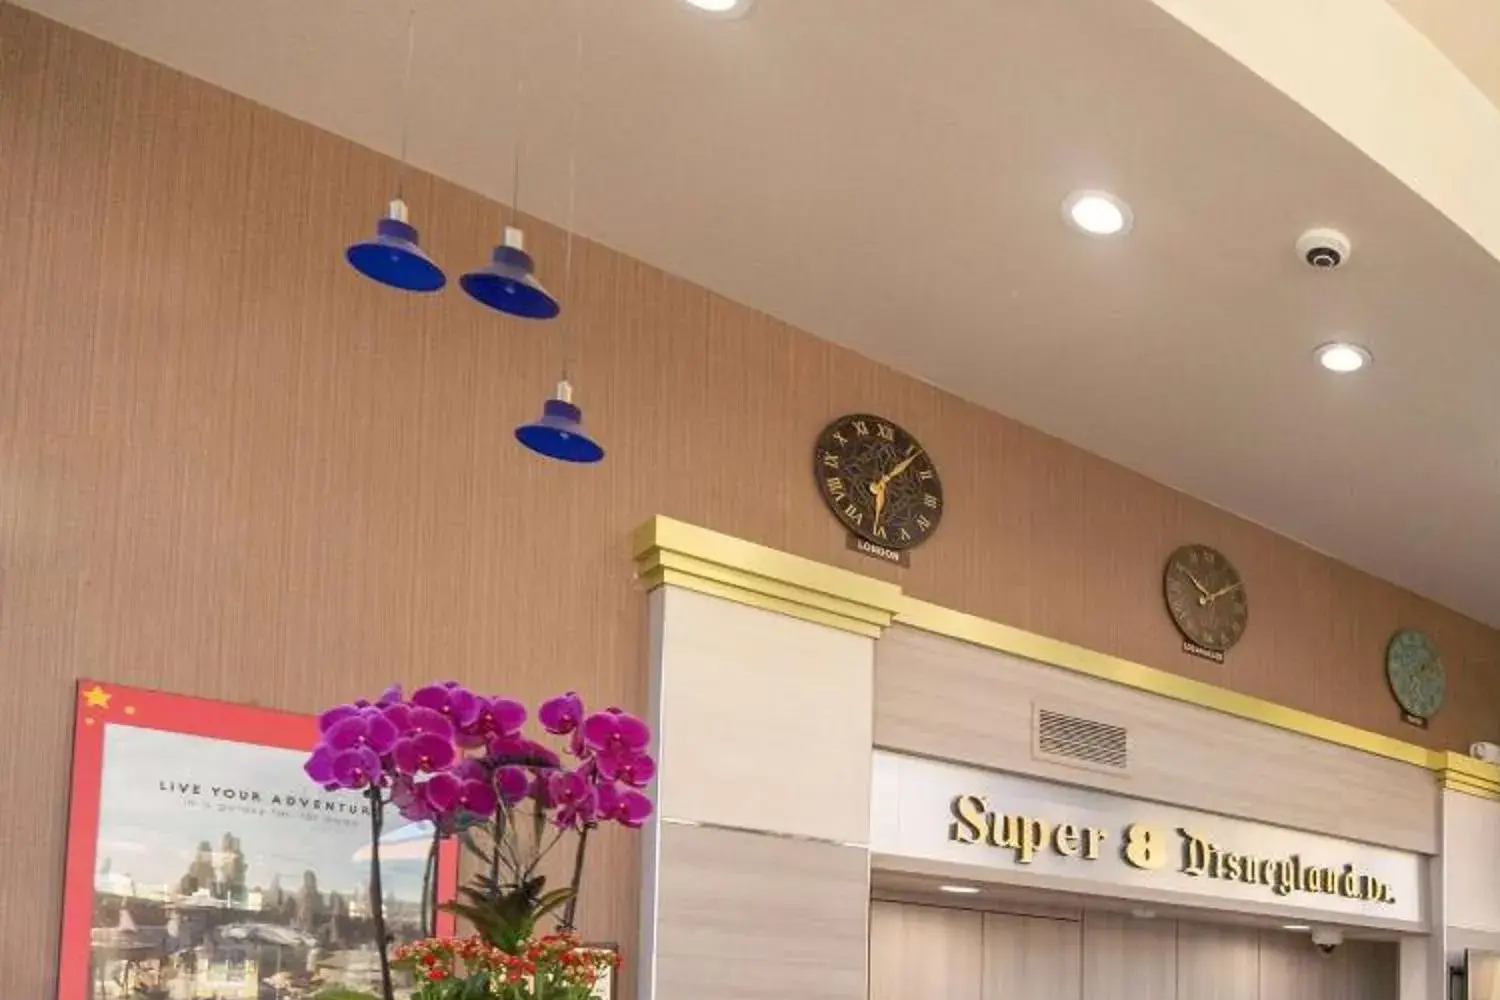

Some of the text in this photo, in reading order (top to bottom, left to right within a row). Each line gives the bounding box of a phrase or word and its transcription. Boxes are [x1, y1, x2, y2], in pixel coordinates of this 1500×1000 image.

[857, 541, 899, 561] LONDON
[159, 781, 201, 795] LIVE
[211, 787, 262, 801] YOUR
[271, 794, 373, 817] ADVENTUR
[950, 794, 1107, 864] Super
[1120, 822, 1167, 870] 8
